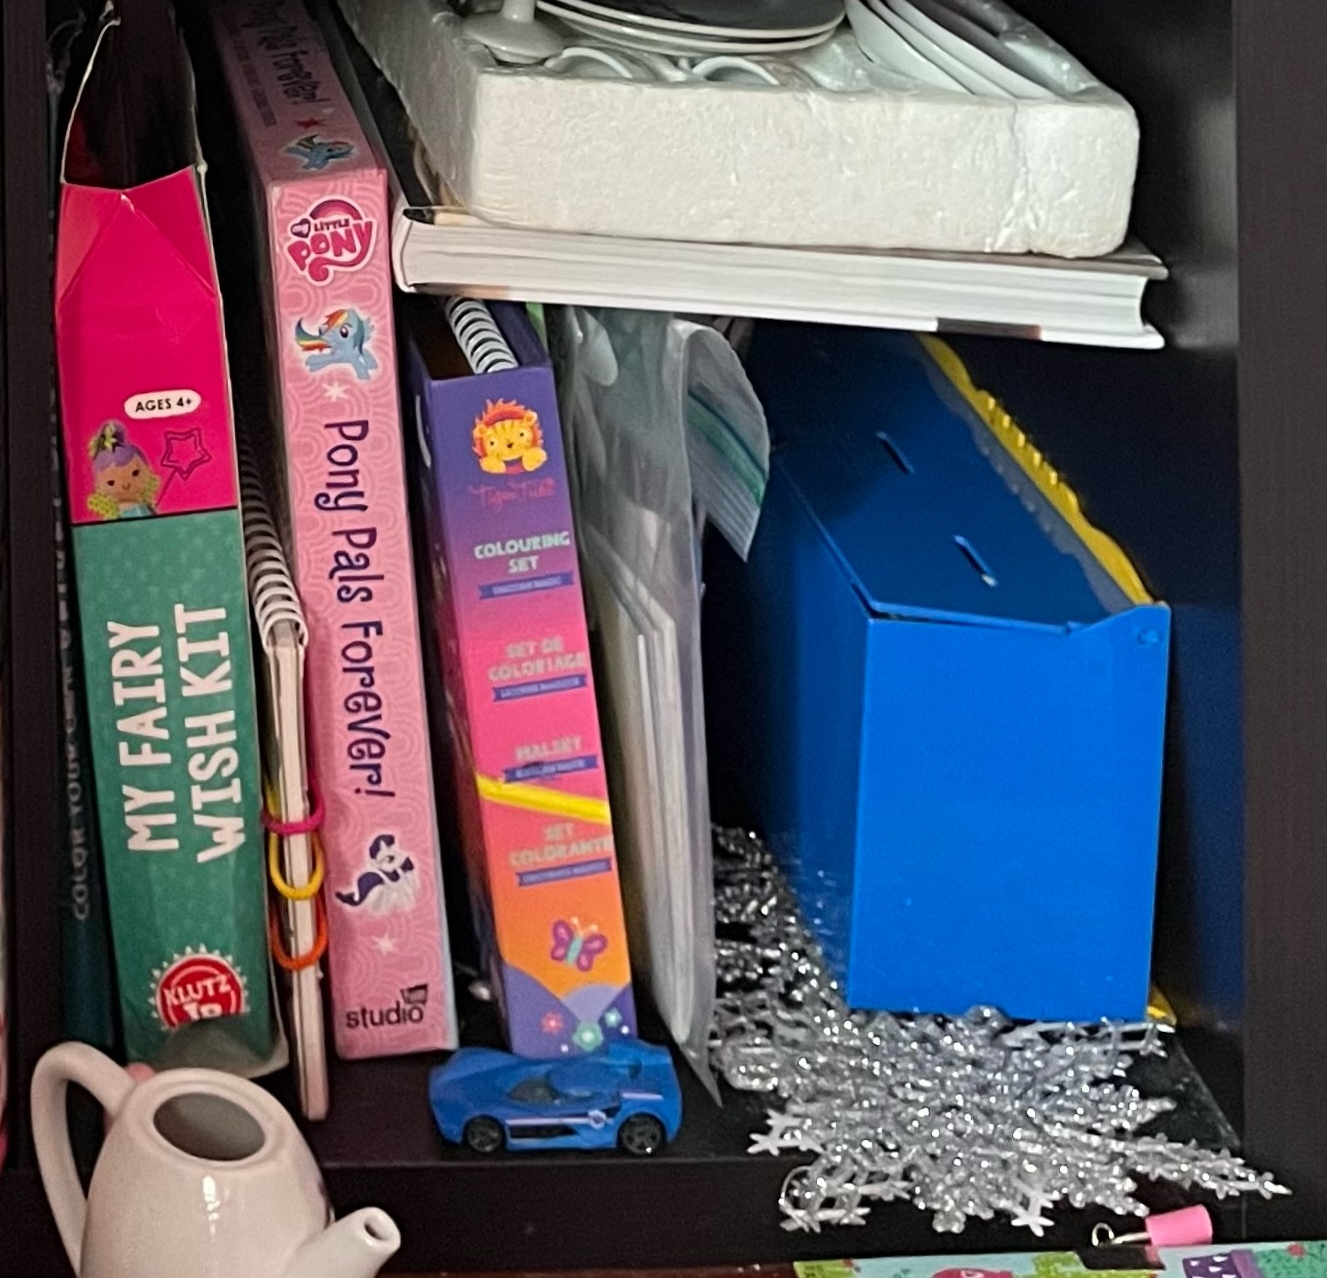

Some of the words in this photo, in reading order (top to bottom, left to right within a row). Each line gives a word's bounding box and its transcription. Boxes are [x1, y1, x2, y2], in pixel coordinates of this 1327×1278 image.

[287, 220, 374, 282] PONY
[314, 218, 350, 232] LITTLE
[134, 398, 172, 413] AGES
[176, 397, 193, 407] 4+
[314, 419, 370, 512] Pony
[329, 527, 386, 604] Pals
[474, 531, 571, 560] COLOURING
[508, 555, 539, 574] SET
[174, 603, 234, 697] KIT
[106, 620, 172, 767] FAIRY
[340, 620, 397, 799] Forever!
[121, 784, 180, 852] MY
[184, 710, 247, 864] WISH
[163, 974, 232, 1006] KLUTZ
[346, 1000, 425, 1030] studio
